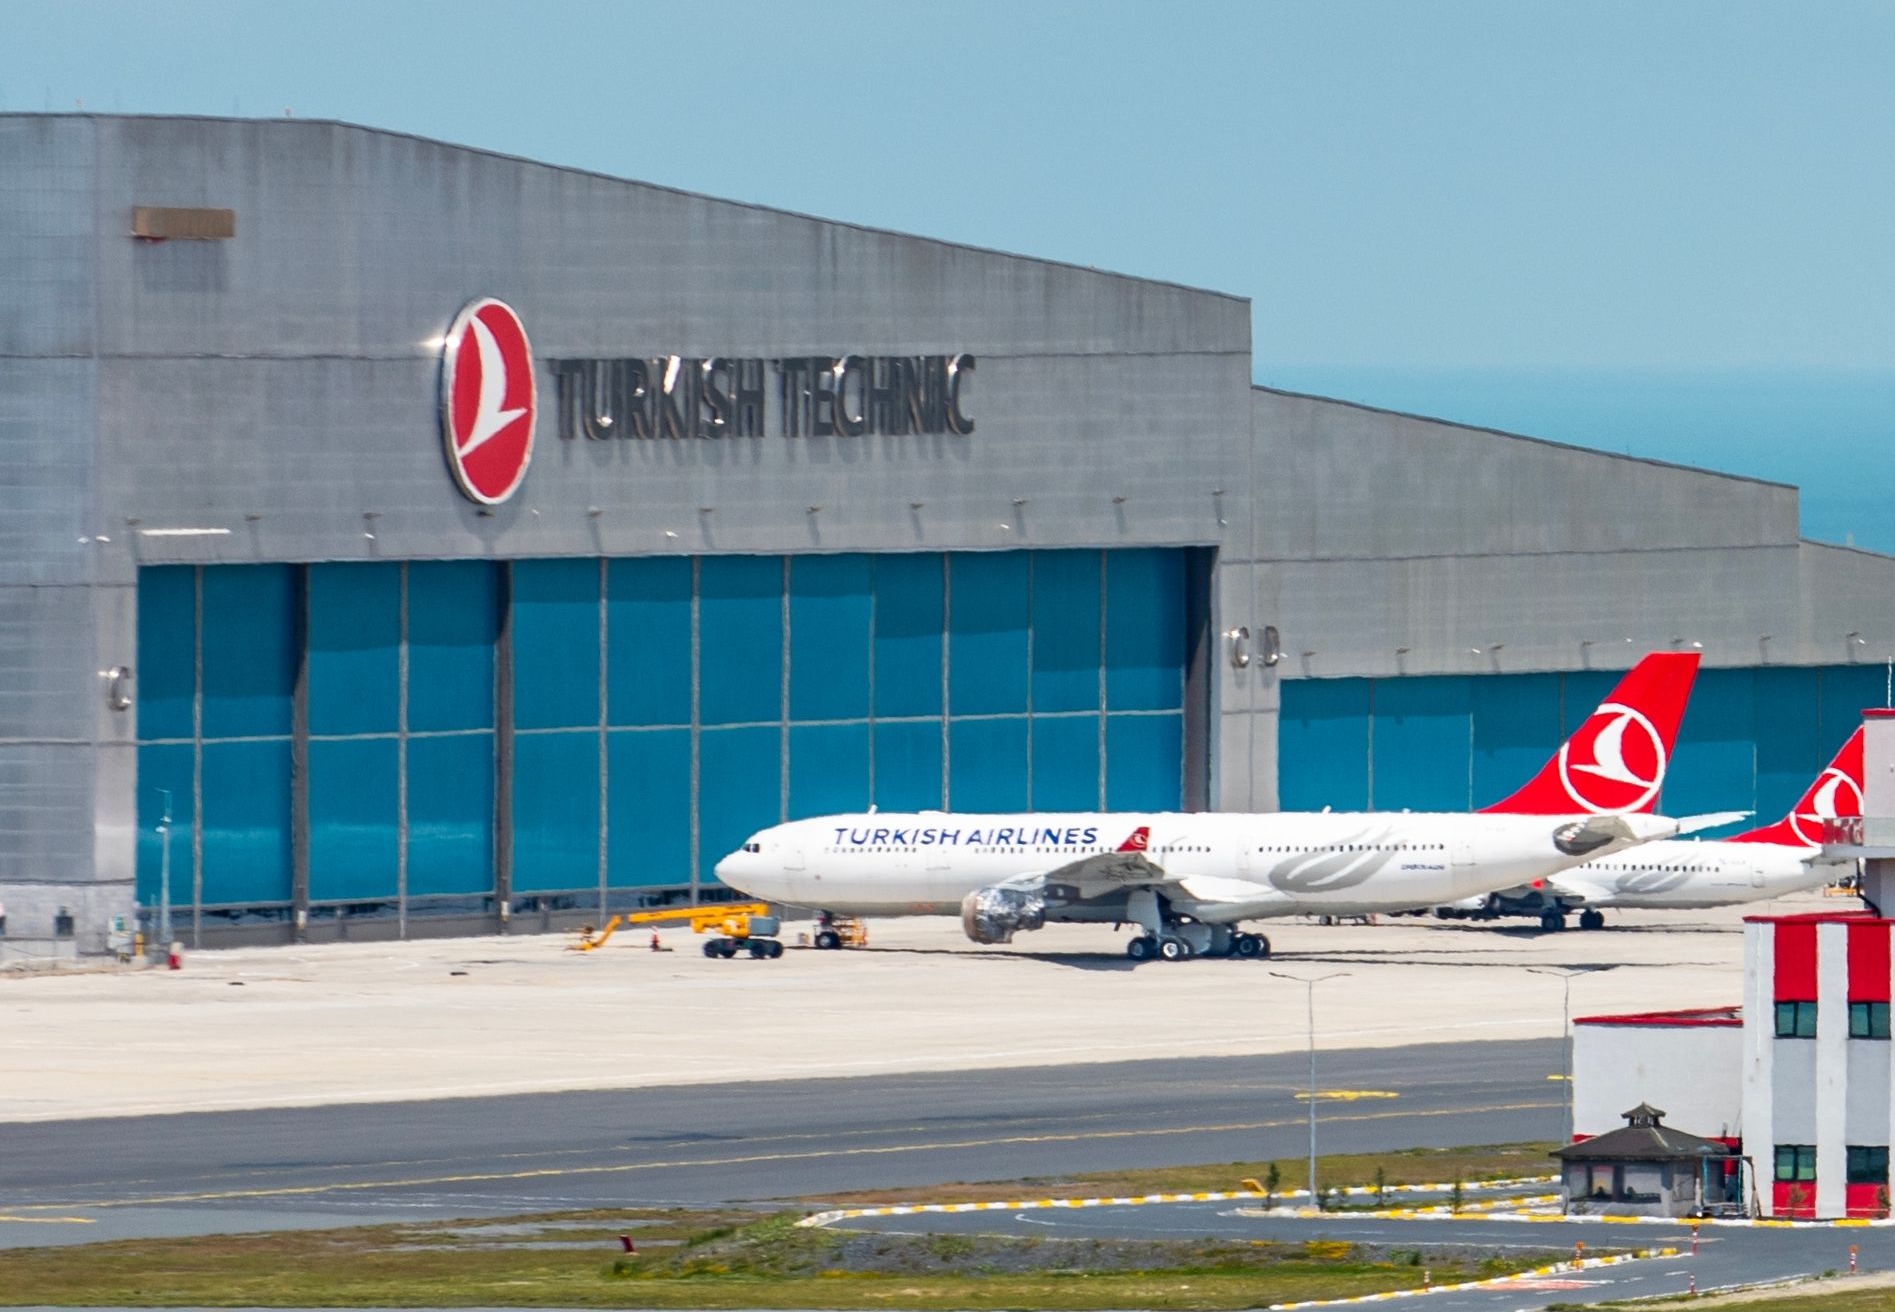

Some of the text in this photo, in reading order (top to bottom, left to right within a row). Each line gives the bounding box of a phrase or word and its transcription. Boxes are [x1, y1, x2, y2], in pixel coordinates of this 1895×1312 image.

[552, 353, 977, 440] TURKISH TECHNIC
[835, 827, 1098, 846] TURKISH AIRLINES
